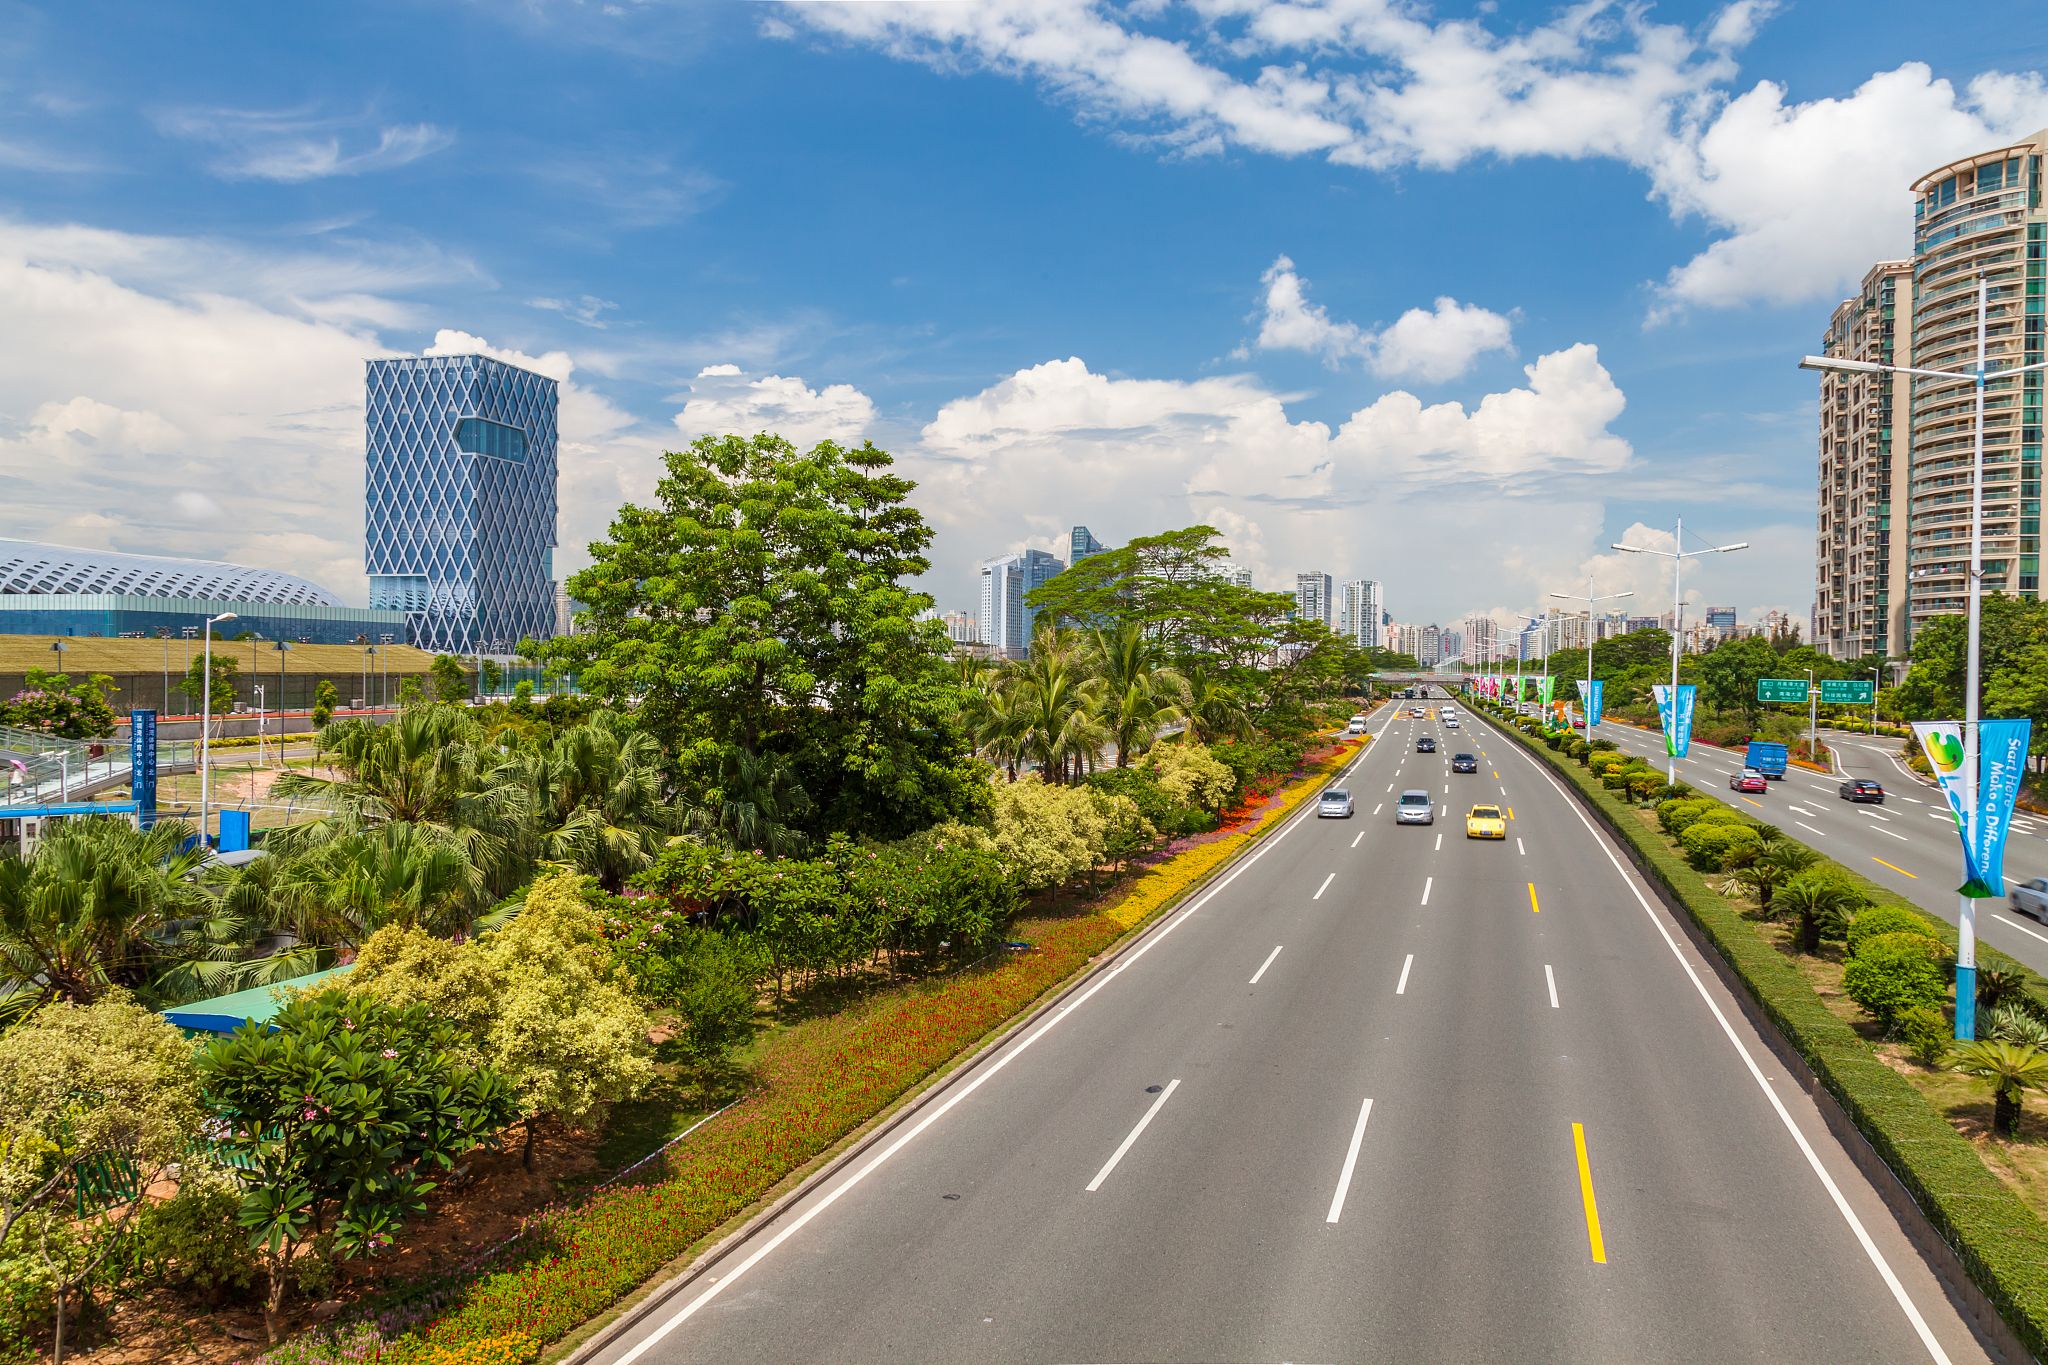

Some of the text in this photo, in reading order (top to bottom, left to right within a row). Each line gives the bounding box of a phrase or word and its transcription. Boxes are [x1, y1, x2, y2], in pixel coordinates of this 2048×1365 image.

[1981, 761, 2005, 878] Make a Differen
[2004, 738, 2021, 808] Start Here
